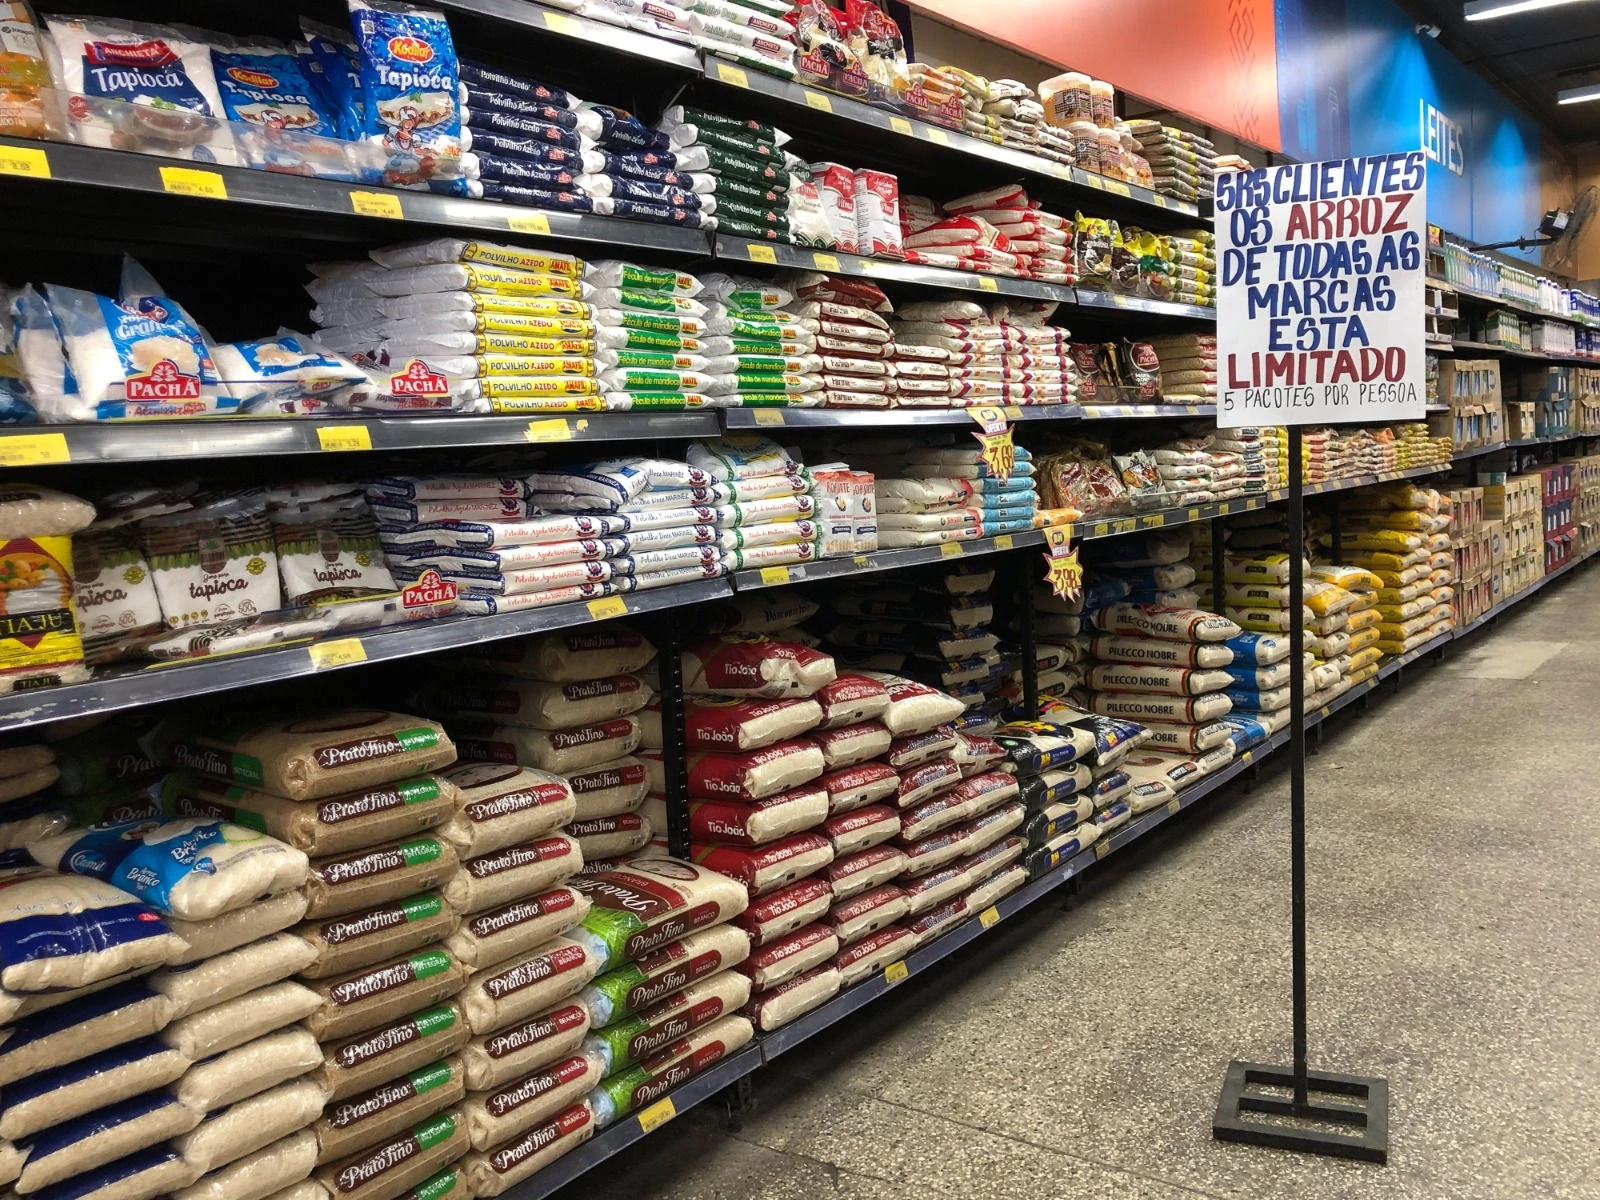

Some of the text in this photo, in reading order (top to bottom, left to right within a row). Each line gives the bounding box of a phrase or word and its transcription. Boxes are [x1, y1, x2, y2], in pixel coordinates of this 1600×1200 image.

[91, 67, 183, 92] Tapioca
[377, 65, 453, 90] Tapioca
[481, 70, 529, 90] Polvilho Azedo
[222, 80, 310, 105] Tapioca
[492, 115, 540, 132] Polvilho Azedo
[494, 138, 521, 151] Polvilho
[1420, 98, 1464, 177] LEITES
[1273, 152, 1425, 204] CLIENTES
[1230, 193, 1414, 247] OS ARROZ
[480, 251, 519, 264] POLVILHO
[520, 258, 545, 267] AZEDO
[1222, 231, 1420, 286] DE TODAS AS
[1248, 276, 1396, 319] MARCAS
[1268, 313, 1369, 351] ESTA
[490, 339, 528, 349] POLVILHO
[647, 358, 674, 366] mandioca
[1228, 347, 1406, 389] LIMITADO
[130, 379, 198, 396] PACHÁ
[394, 377, 447, 392] PACHÁ
[494, 383, 532, 391] POLVILHO
[1224, 383, 1417, 411] 5 PACOTES POR PESSOA
[314, 568, 361, 585] tapioca
[190, 578, 248, 601] tapioca
[405, 584, 455, 605] PACHÁ
[76, 588, 127, 612] pioca
[0, 619, 33, 636] TIA
[1109, 647, 1177, 661] PILECCO NOBRE
[1103, 674, 1169, 687] PILECCO NOBRE
[1107, 703, 1174, 714] PILECCO NOBRE
[1151, 732, 1178, 744] NOBRE
[127, 867, 161, 886] Branco
[693, 911, 715, 925] BRANCO
[696, 960, 717, 974] BRANCO
[559, 1011, 582, 1025] BRANCO
[697, 1006, 718, 1021] BRANCO
[699, 1050, 720, 1066] BRANCO
[563, 1111, 586, 1127] BRANCO
